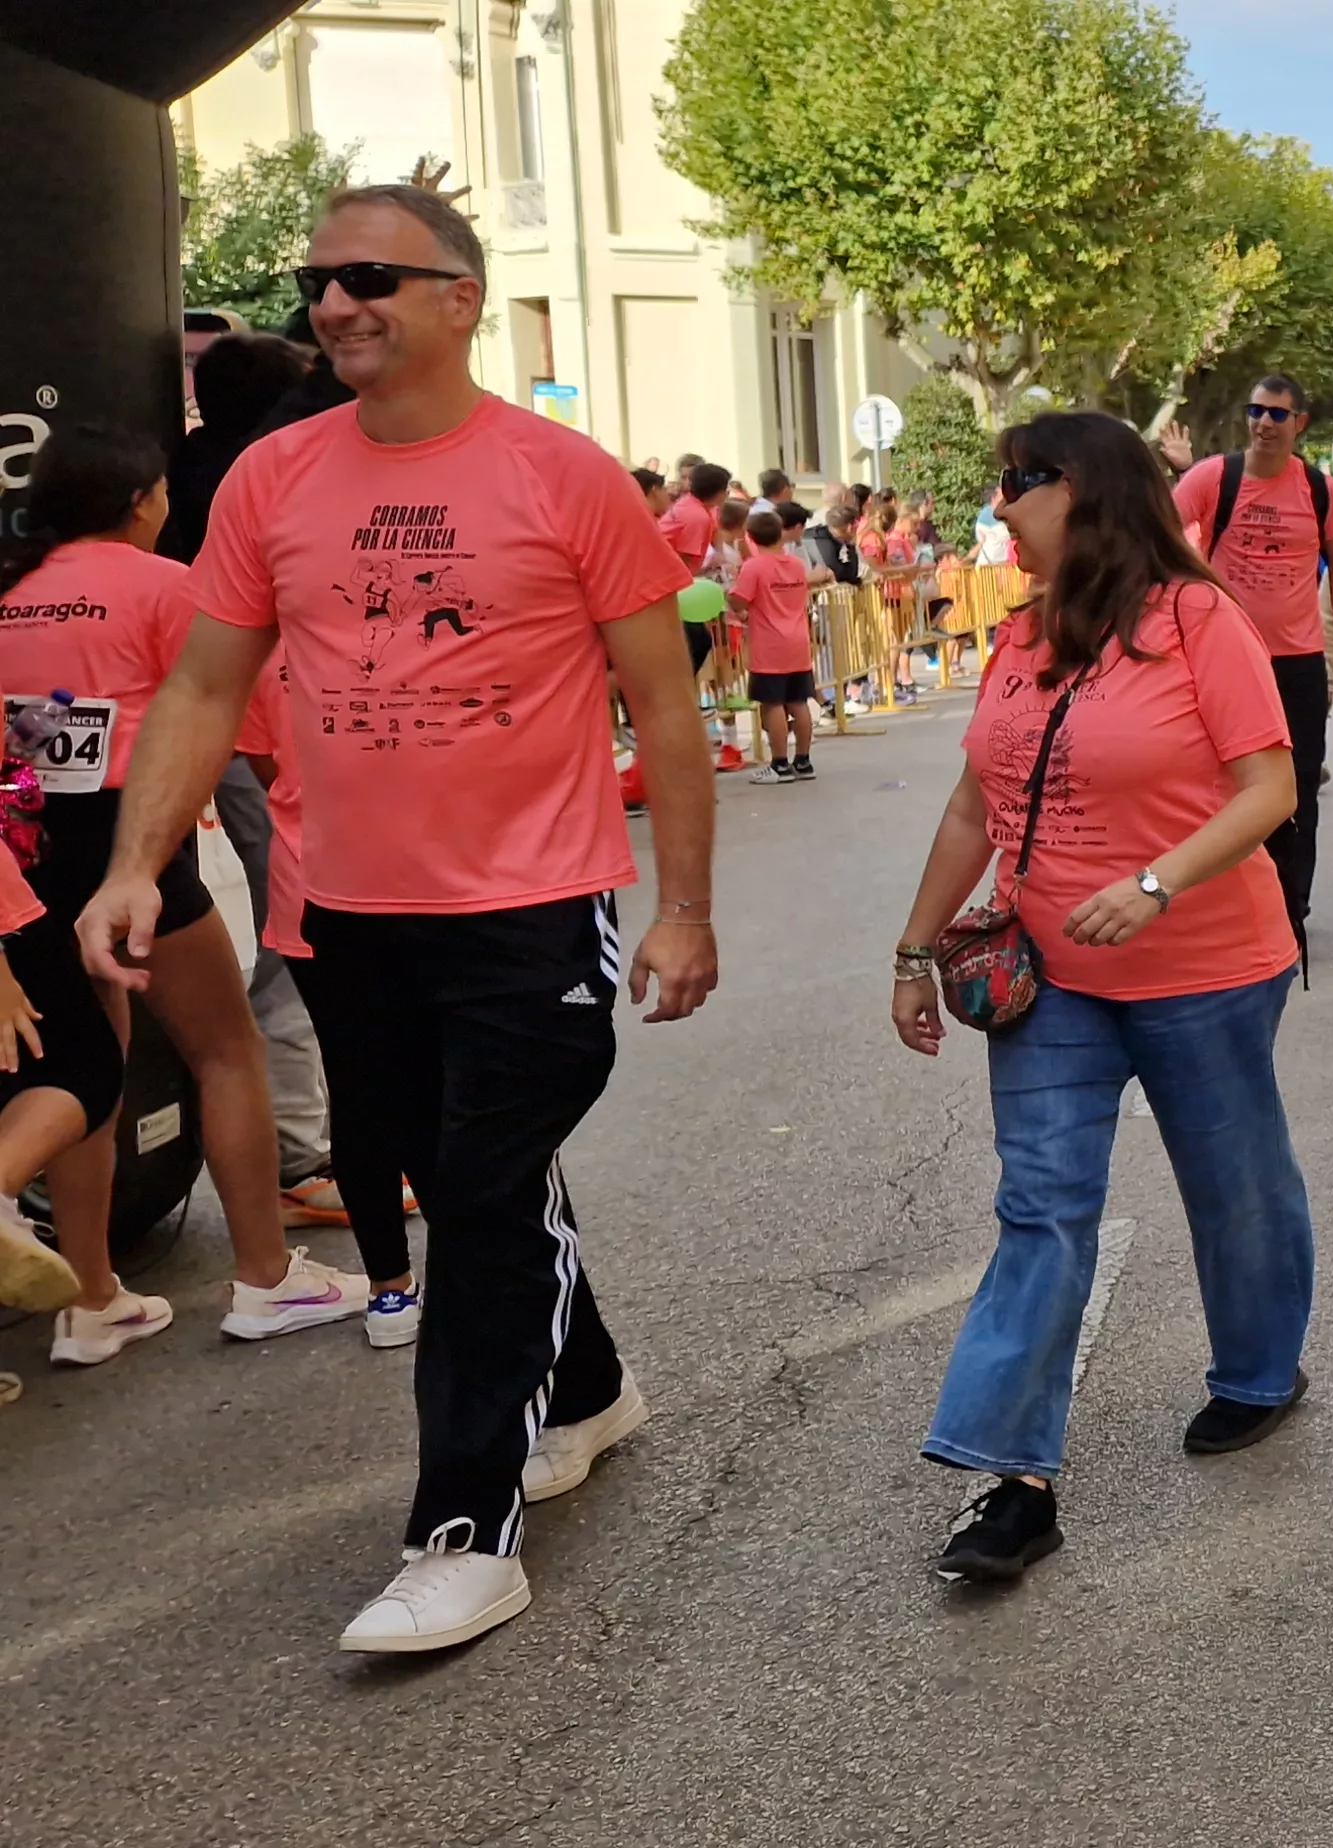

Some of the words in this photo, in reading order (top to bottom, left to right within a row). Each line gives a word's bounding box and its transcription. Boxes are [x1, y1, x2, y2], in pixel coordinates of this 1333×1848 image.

[369, 505, 448, 527] CORRAMOS
[351, 528, 381, 550] POR
[382, 528, 399, 550] LA
[401, 528, 456, 550] CIENCIA
[66, 715, 103, 726] ANCER
